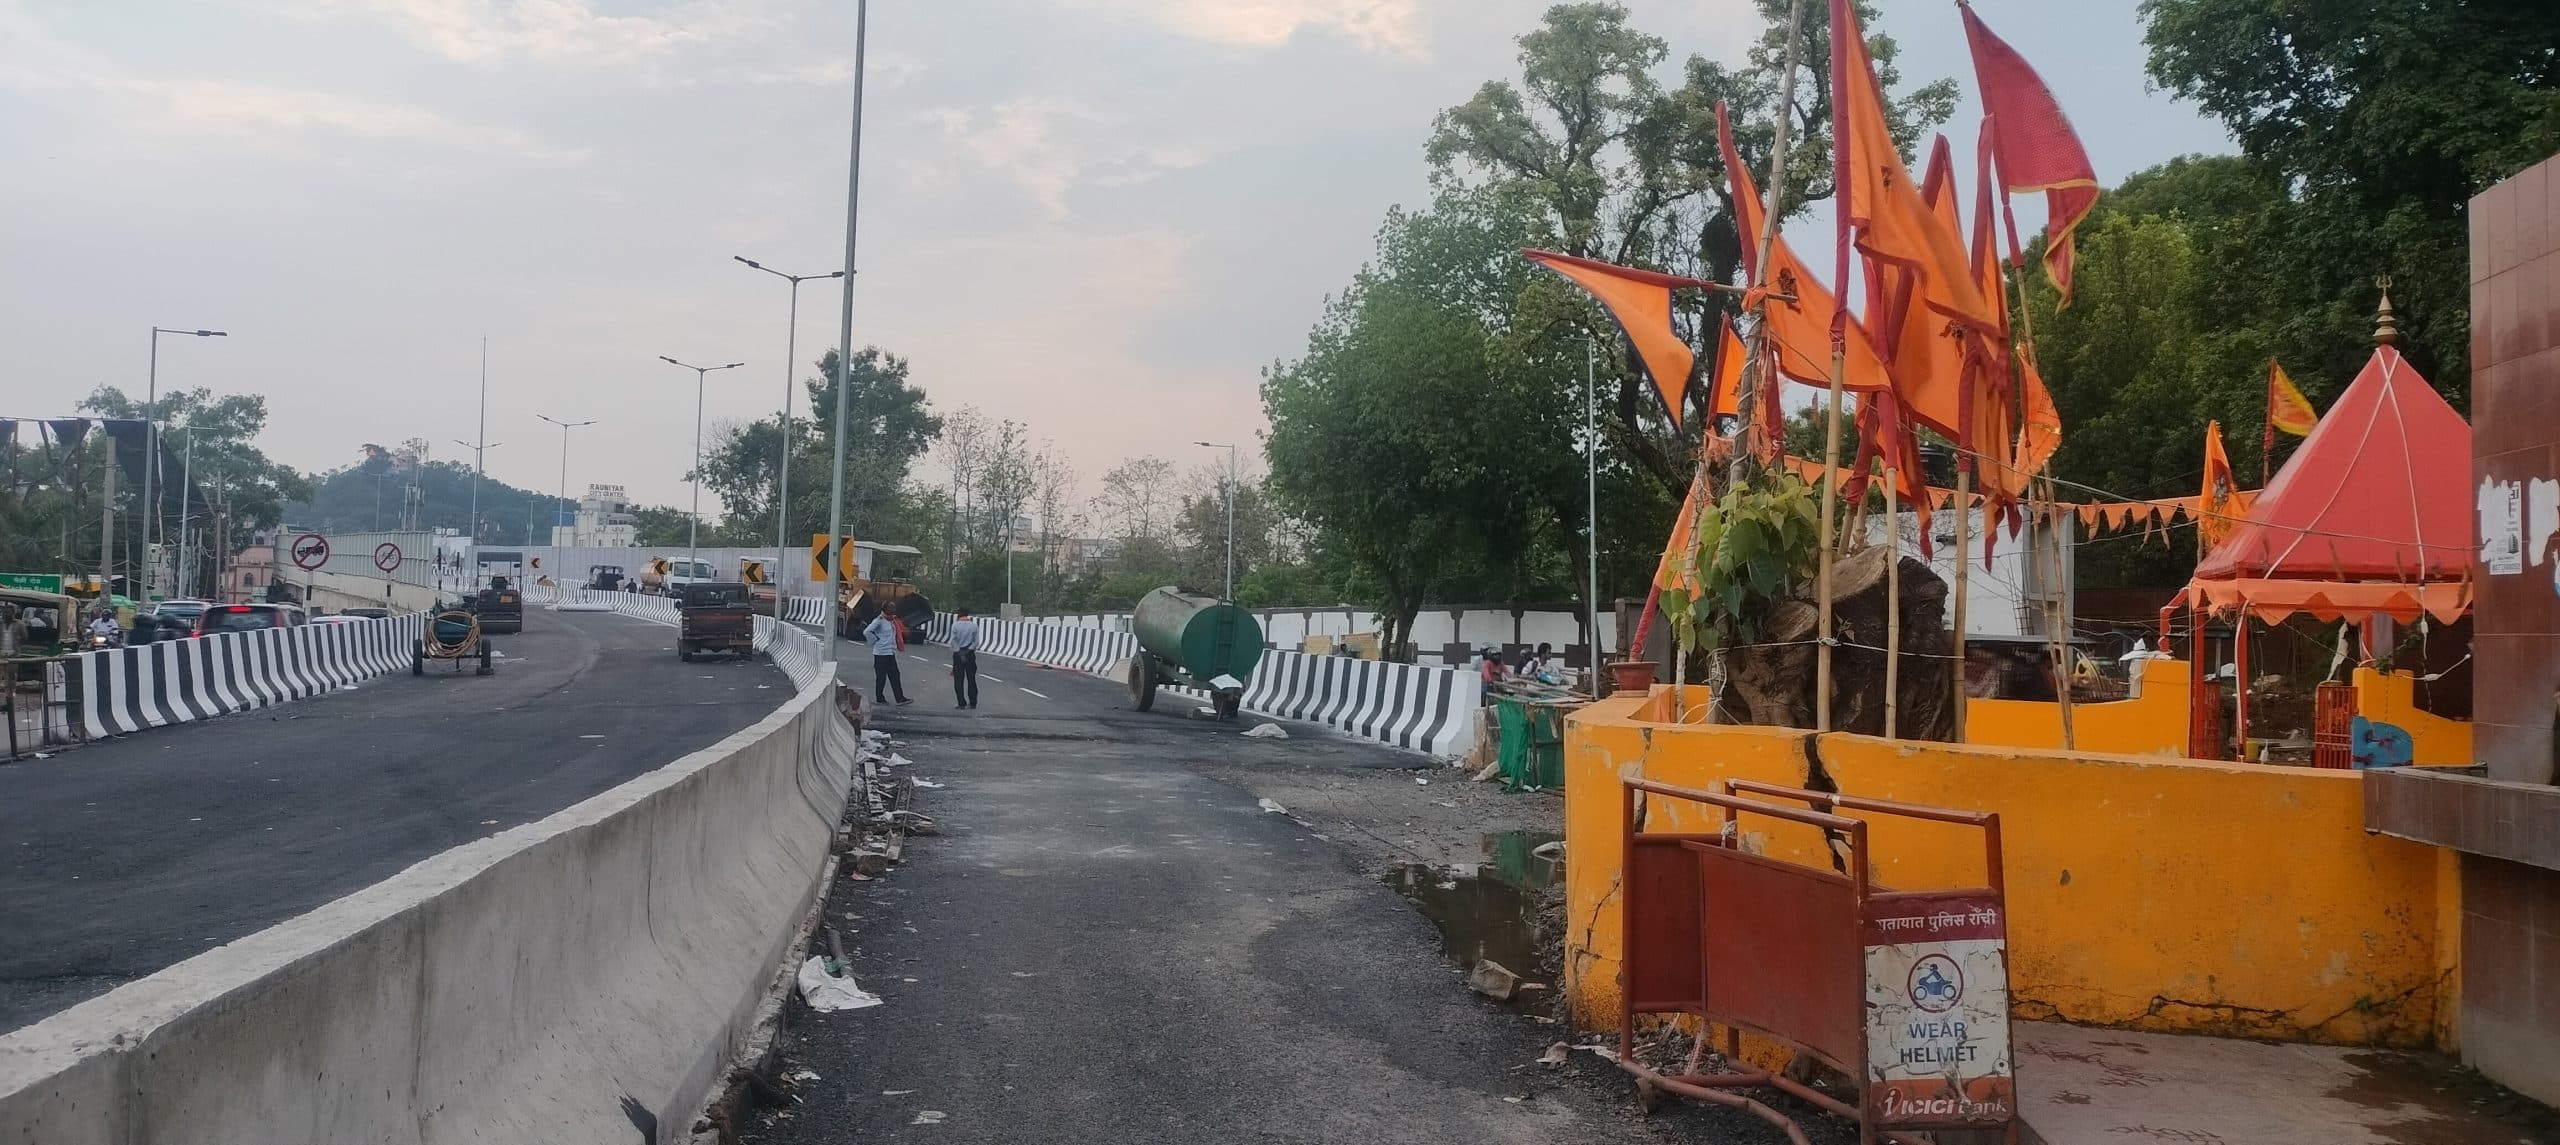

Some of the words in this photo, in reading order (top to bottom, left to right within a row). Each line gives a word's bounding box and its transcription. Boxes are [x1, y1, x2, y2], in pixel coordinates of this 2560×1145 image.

[590, 483, 624, 491] RAUNIYAR
[1928, 911, 1966, 933] पुलिस
[1968, 907, 1997, 927] राँची
[1909, 1022, 1968, 1040] WEAR
[1900, 1045, 1978, 1064] HELMET
